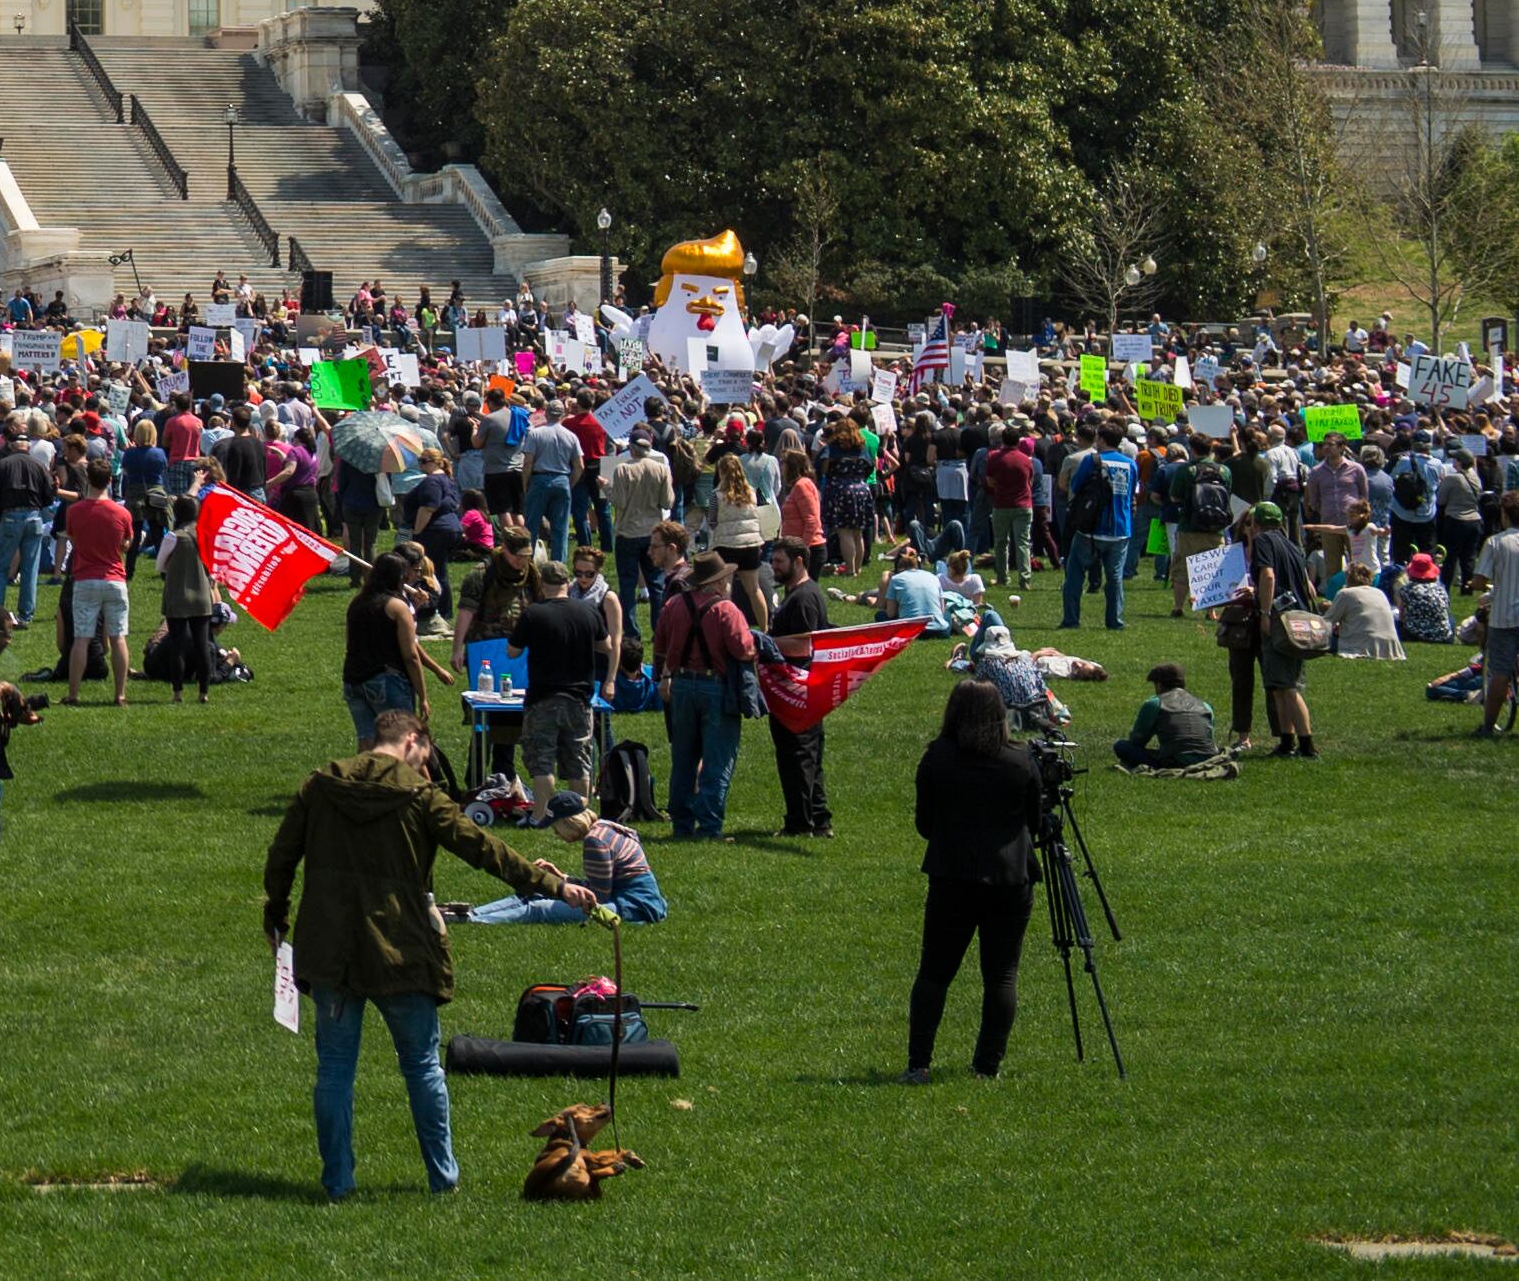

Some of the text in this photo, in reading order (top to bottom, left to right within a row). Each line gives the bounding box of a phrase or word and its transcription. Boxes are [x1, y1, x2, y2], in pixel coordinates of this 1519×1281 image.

[1415, 356, 1469, 388] FAKE
[1140, 382, 1179, 402] TRUTH DIED
[1420, 382, 1454, 404] 45
[597, 407, 614, 420] TAX
[619, 398, 644, 420] NOT
[1154, 402, 1180, 419] TRUMP
[1188, 547, 1230, 565] YES WE
[1193, 561, 1219, 573] CARE
[1191, 569, 1224, 584] ABOUT
[1193, 582, 1222, 595] YOUR
[1195, 592, 1225, 607] TAXES
